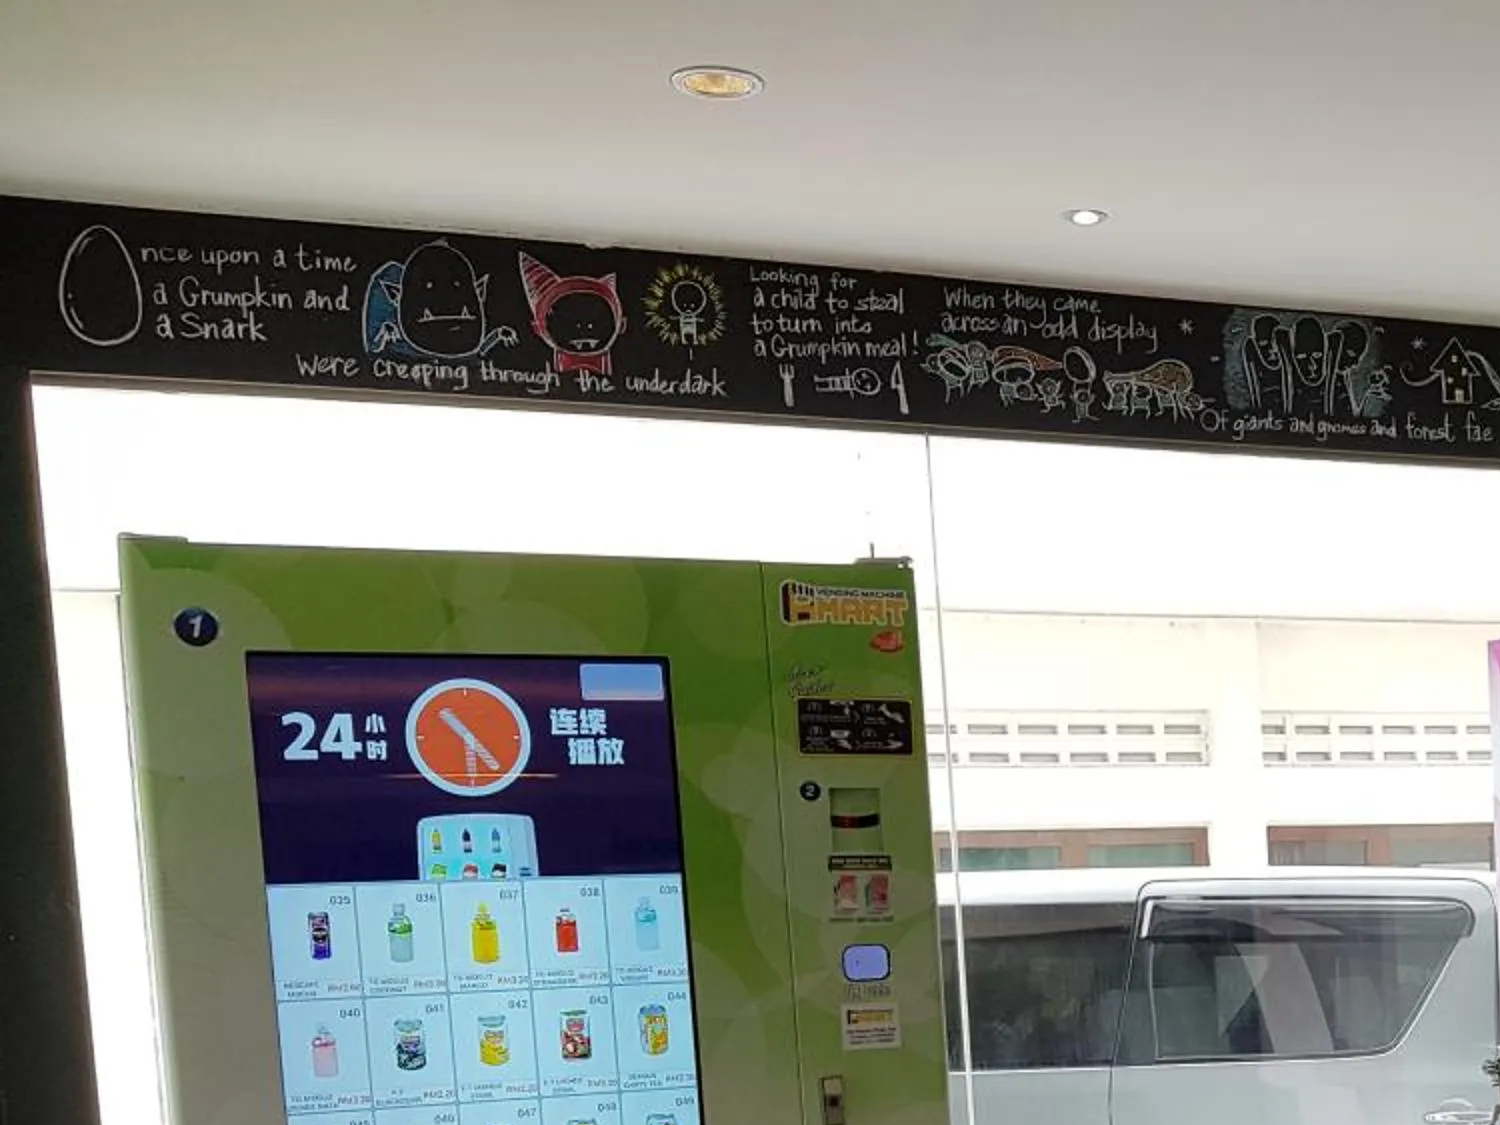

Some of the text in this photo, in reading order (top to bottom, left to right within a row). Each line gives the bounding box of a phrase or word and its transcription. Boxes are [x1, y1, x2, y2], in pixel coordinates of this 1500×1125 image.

[201, 248, 260, 275] upon
[272, 250, 287, 269] a
[298, 248, 358, 273] time
[153, 276, 349, 316] a Grumpkin and
[750, 266, 858, 297] Looking for
[753, 287, 765, 308] a
[771, 288, 816, 310] child
[825, 291, 849, 314] to
[943, 285, 995, 310] When
[1002, 288, 1047, 328] they
[156, 313, 268, 342] a Snark
[750, 313, 872, 335] to turn into
[941, 312, 1158, 354] across an odd display
[754, 340, 767, 358] a
[771, 333, 861, 365] Grumpkin
[481, 361, 560, 394] through
[574, 370, 615, 393] the
[1233, 412, 1284, 440] giants
[1289, 415, 1315, 435] and
[1370, 418, 1397, 438] and
[281, 711, 363, 761] 24
[550, 708, 608, 736] 连续
[567, 737, 625, 766] 播放
